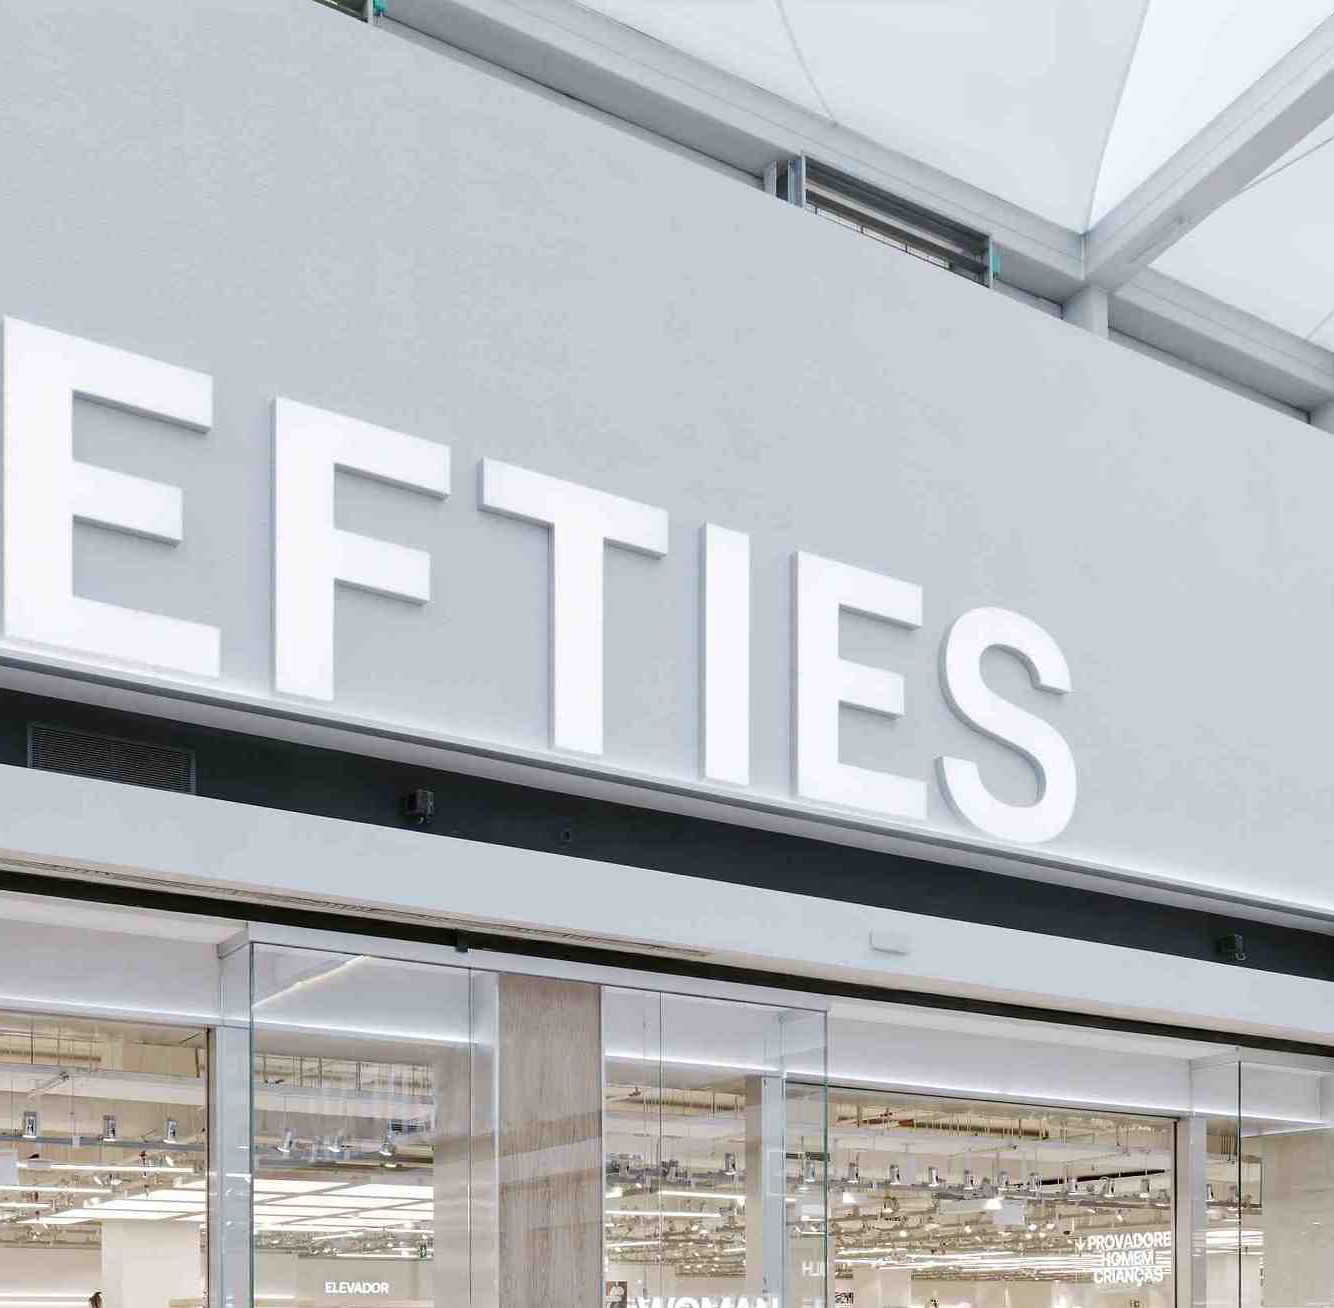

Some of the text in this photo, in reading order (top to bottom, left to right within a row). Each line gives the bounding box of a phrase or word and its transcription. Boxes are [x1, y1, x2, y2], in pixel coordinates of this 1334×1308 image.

[1102, 1249, 1154, 1266] HOMEM
[1094, 1266, 1164, 1287] CRIANÇAS
[325, 1281, 390, 1295] ELEVADOR
